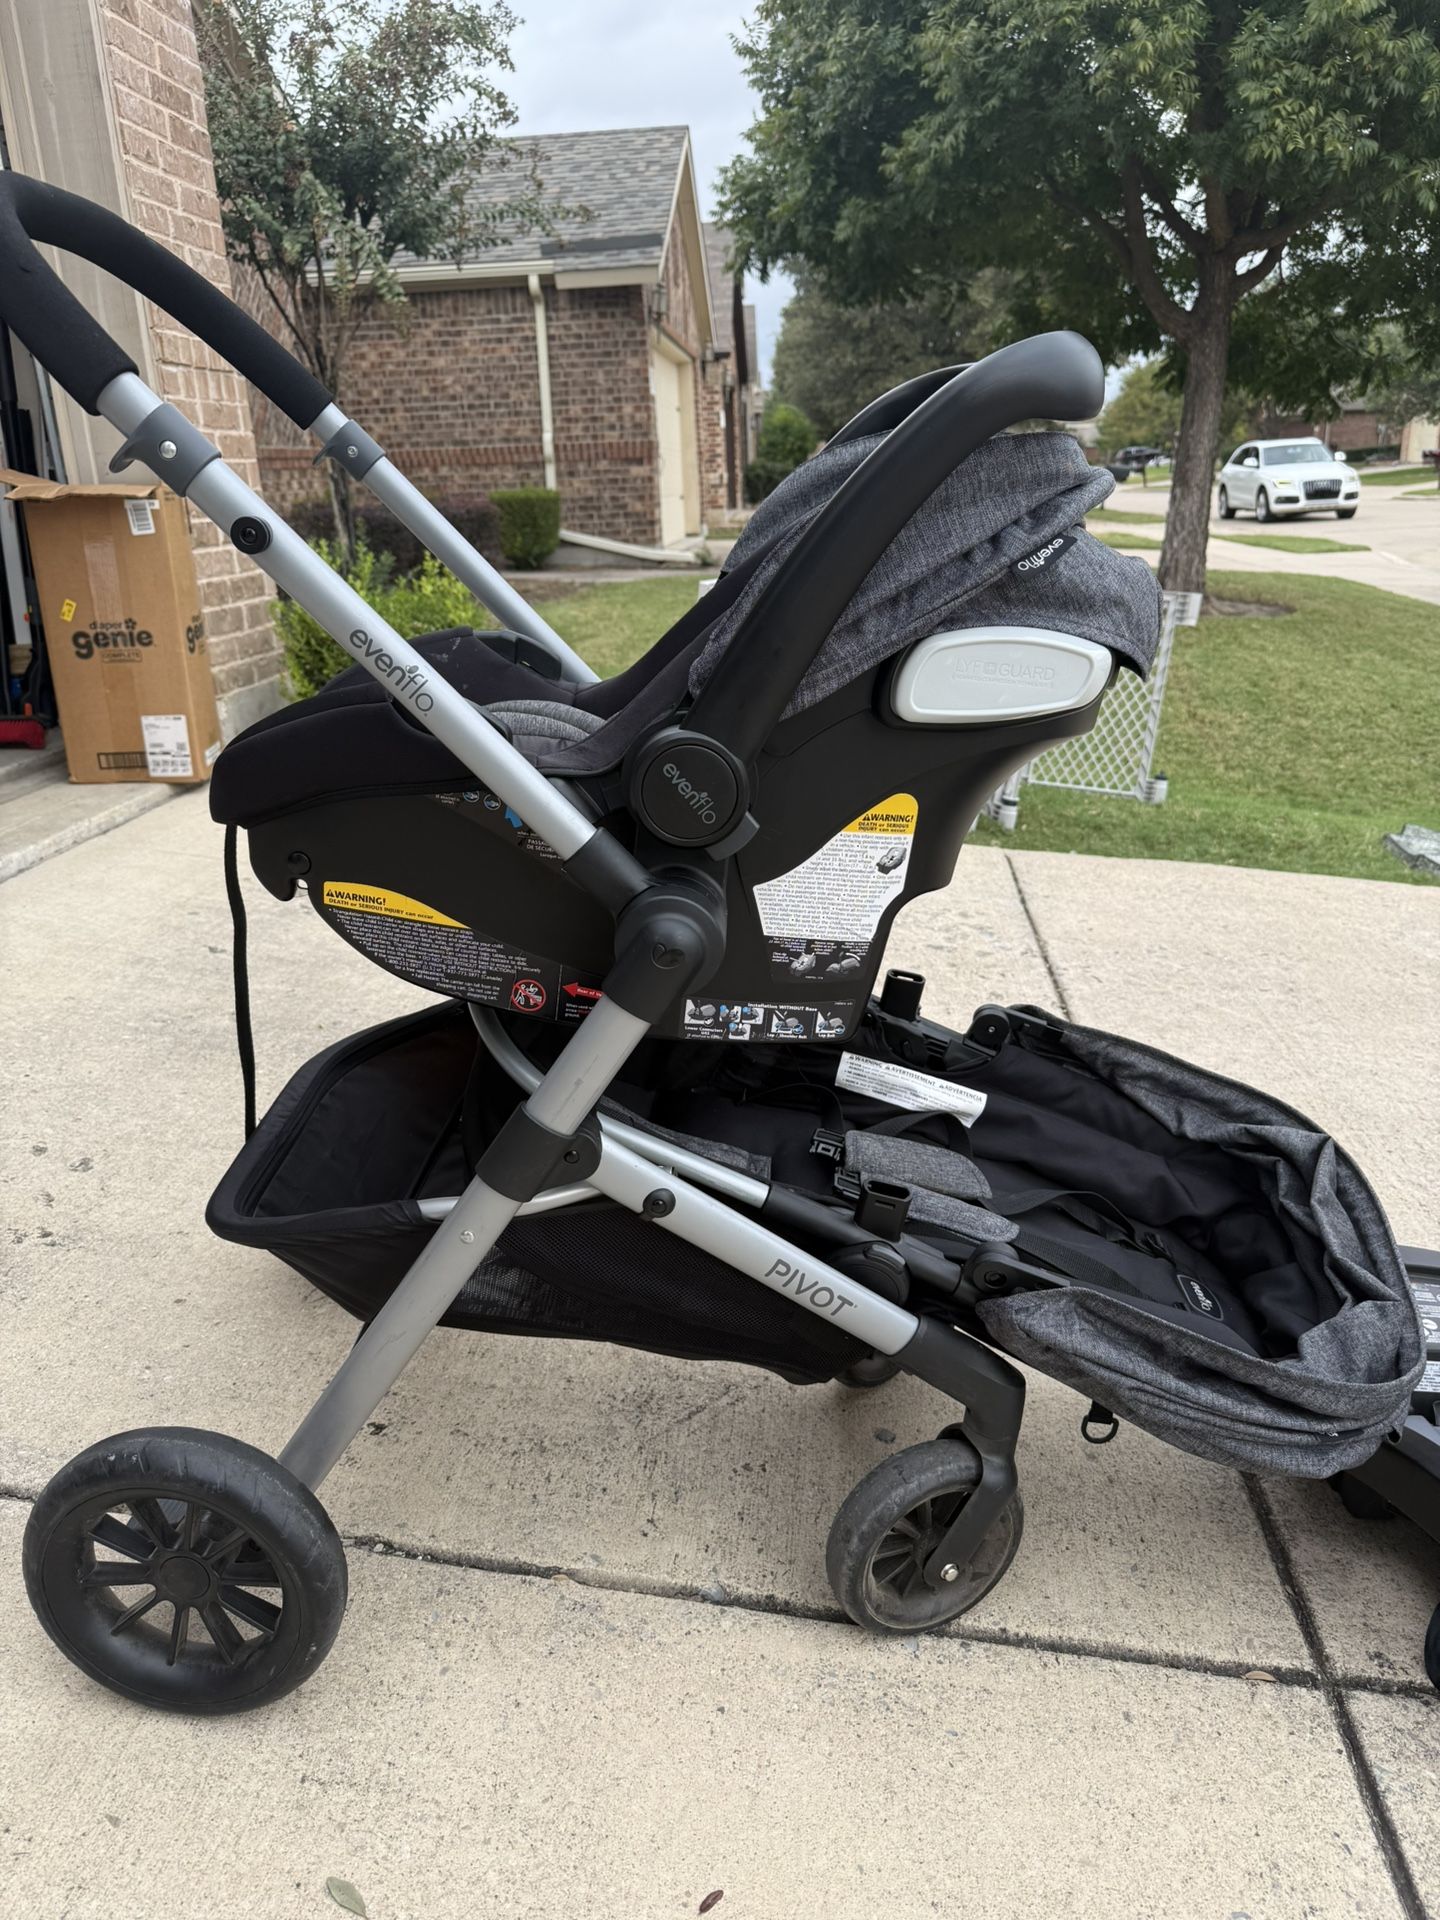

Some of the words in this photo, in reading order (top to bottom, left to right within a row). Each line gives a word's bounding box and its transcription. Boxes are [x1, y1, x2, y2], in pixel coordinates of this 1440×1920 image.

[1018, 538, 1064, 571] evenflo
[89, 620, 122, 630] diaper
[72, 629, 153, 660] genie
[349, 628, 434, 714] evenflo
[999, 663, 1055, 680] GUARD
[663, 762, 717, 825] evenflo
[870, 813, 914, 823] WARNING!
[334, 890, 386, 905] WARNING!
[748, 1002, 778, 1010] Installation
[854, 1055, 882, 1068] WARNING
[891, 1067, 936, 1087] AVERTISSEMENT
[944, 1084, 983, 1102] ADVERTENCIA
[765, 1258, 853, 1316] PIVOT
[1190, 1281, 1211, 1311] evenflo
